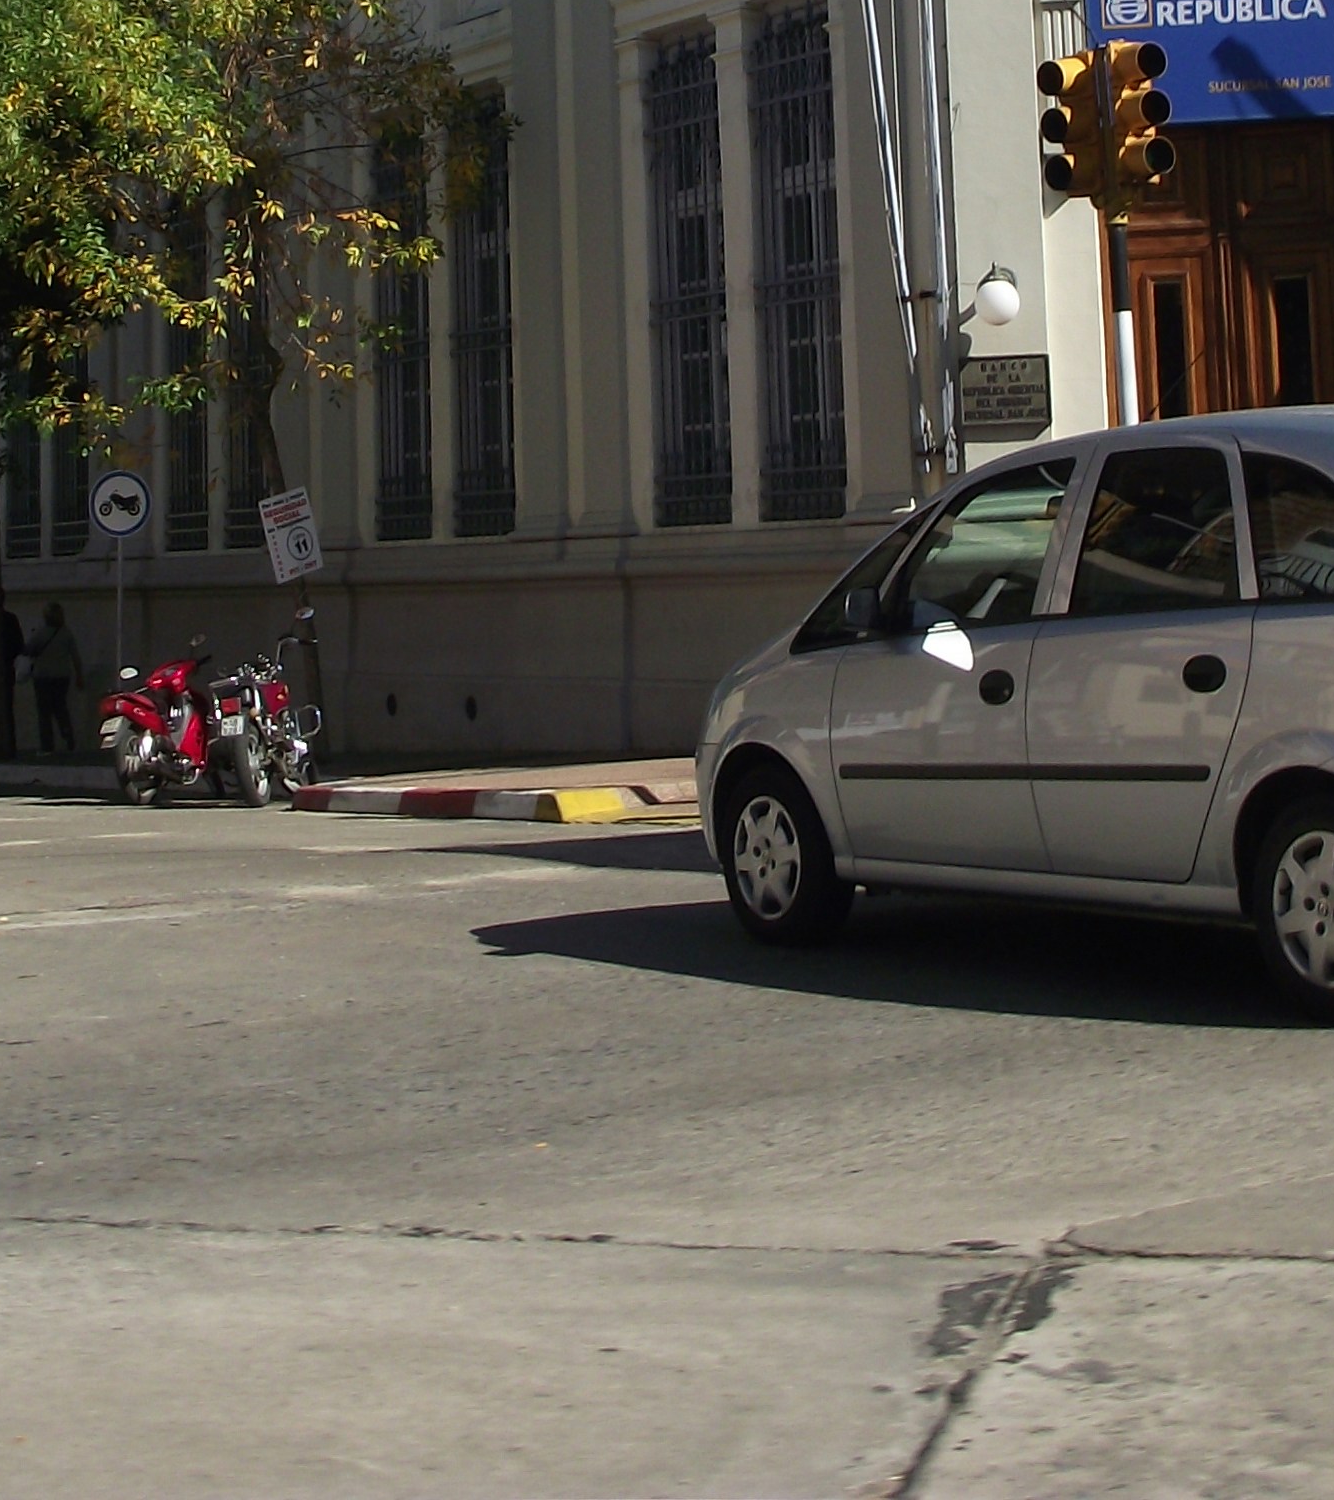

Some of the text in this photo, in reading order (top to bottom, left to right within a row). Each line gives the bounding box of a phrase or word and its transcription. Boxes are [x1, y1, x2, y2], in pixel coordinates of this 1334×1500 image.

[1274, 77, 1299, 90] SAN
[1302, 75, 1332, 90] JOSE
[979, 360, 1028, 373] BANCO
[1008, 373, 1021, 382] LA
[294, 538, 308, 554] 11
